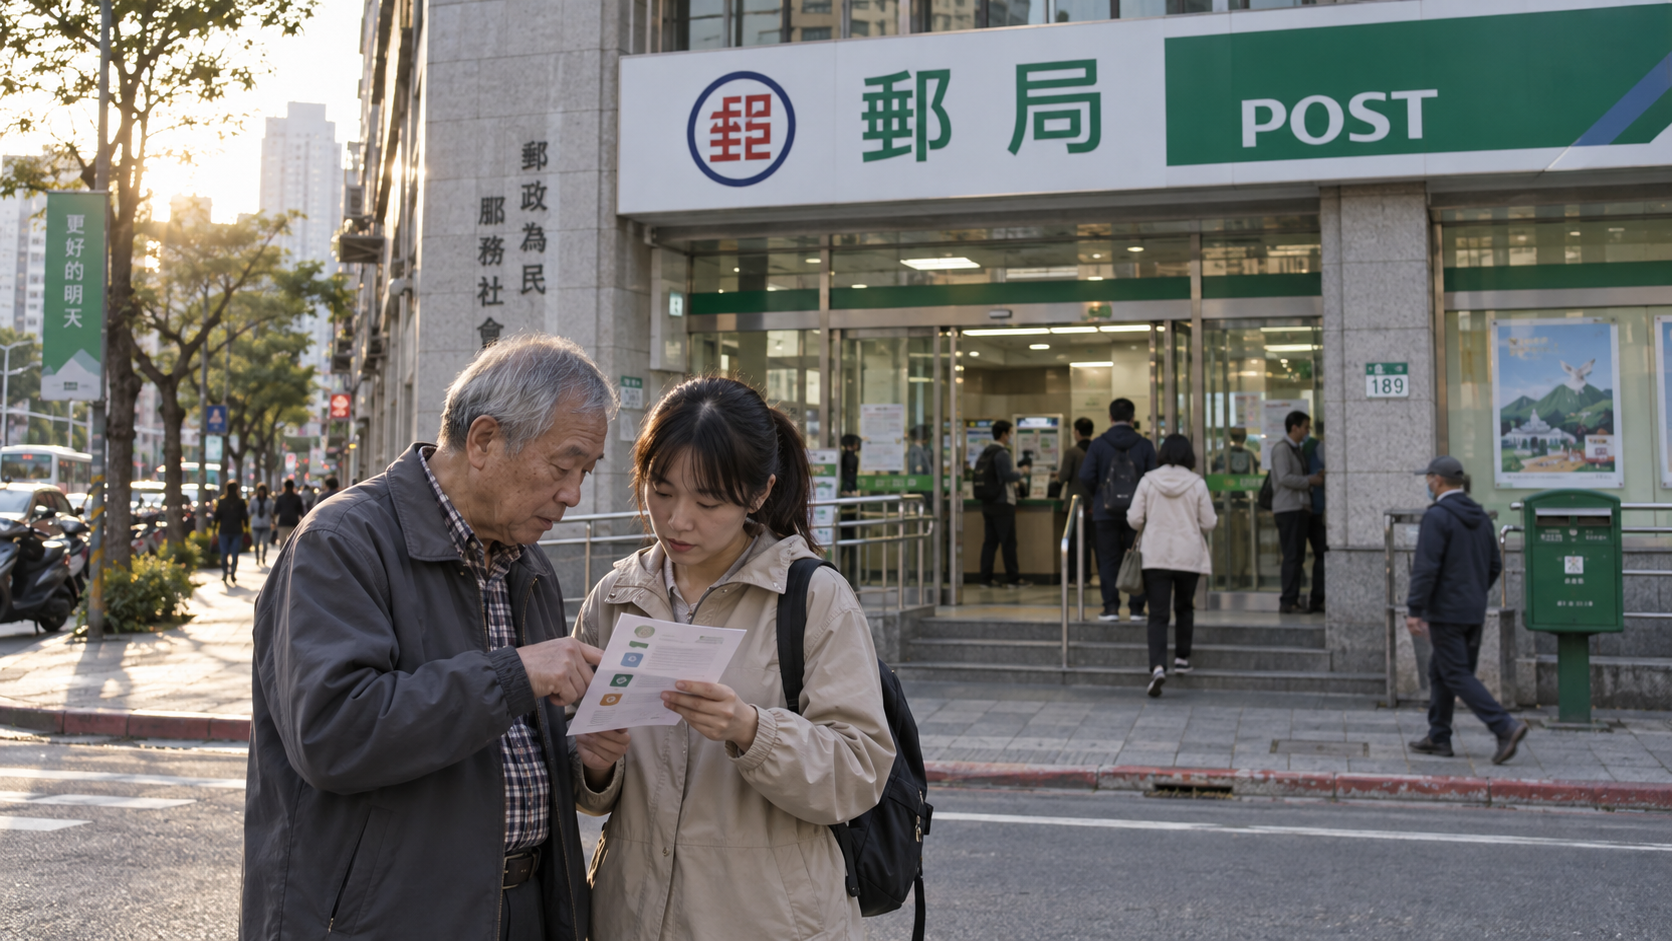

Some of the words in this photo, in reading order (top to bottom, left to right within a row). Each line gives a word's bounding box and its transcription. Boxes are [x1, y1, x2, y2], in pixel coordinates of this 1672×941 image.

[861, 59, 1102, 163] 郵局
[1241, 89, 1438, 148] POST
[520, 140, 548, 295] 郵政為民
[63, 214, 85, 328] 更好的明天
[1371, 377, 1404, 395] 189
